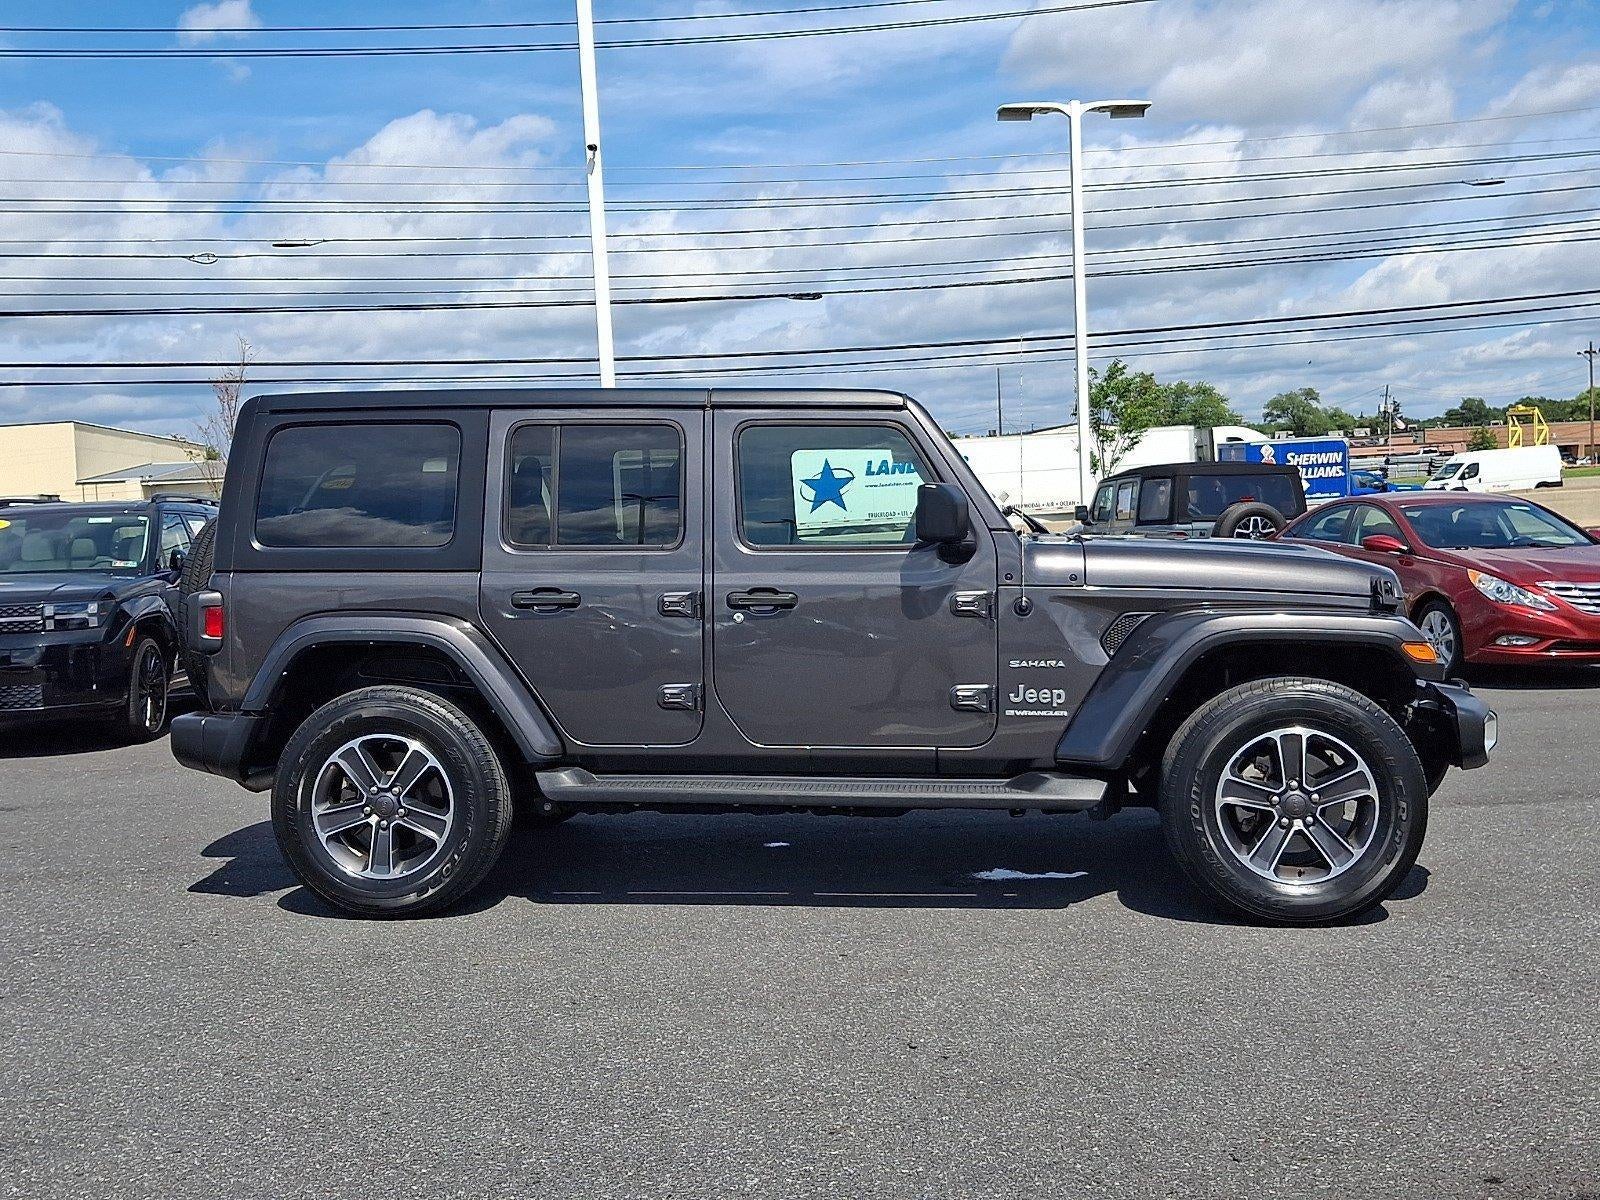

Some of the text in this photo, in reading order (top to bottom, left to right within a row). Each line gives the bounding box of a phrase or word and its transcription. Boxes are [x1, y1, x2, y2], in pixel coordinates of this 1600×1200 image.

[1286, 452, 1343, 465] SHERWIN
[1009, 660, 1066, 668] SAHARA
[1009, 684, 1066, 707] Jeep
